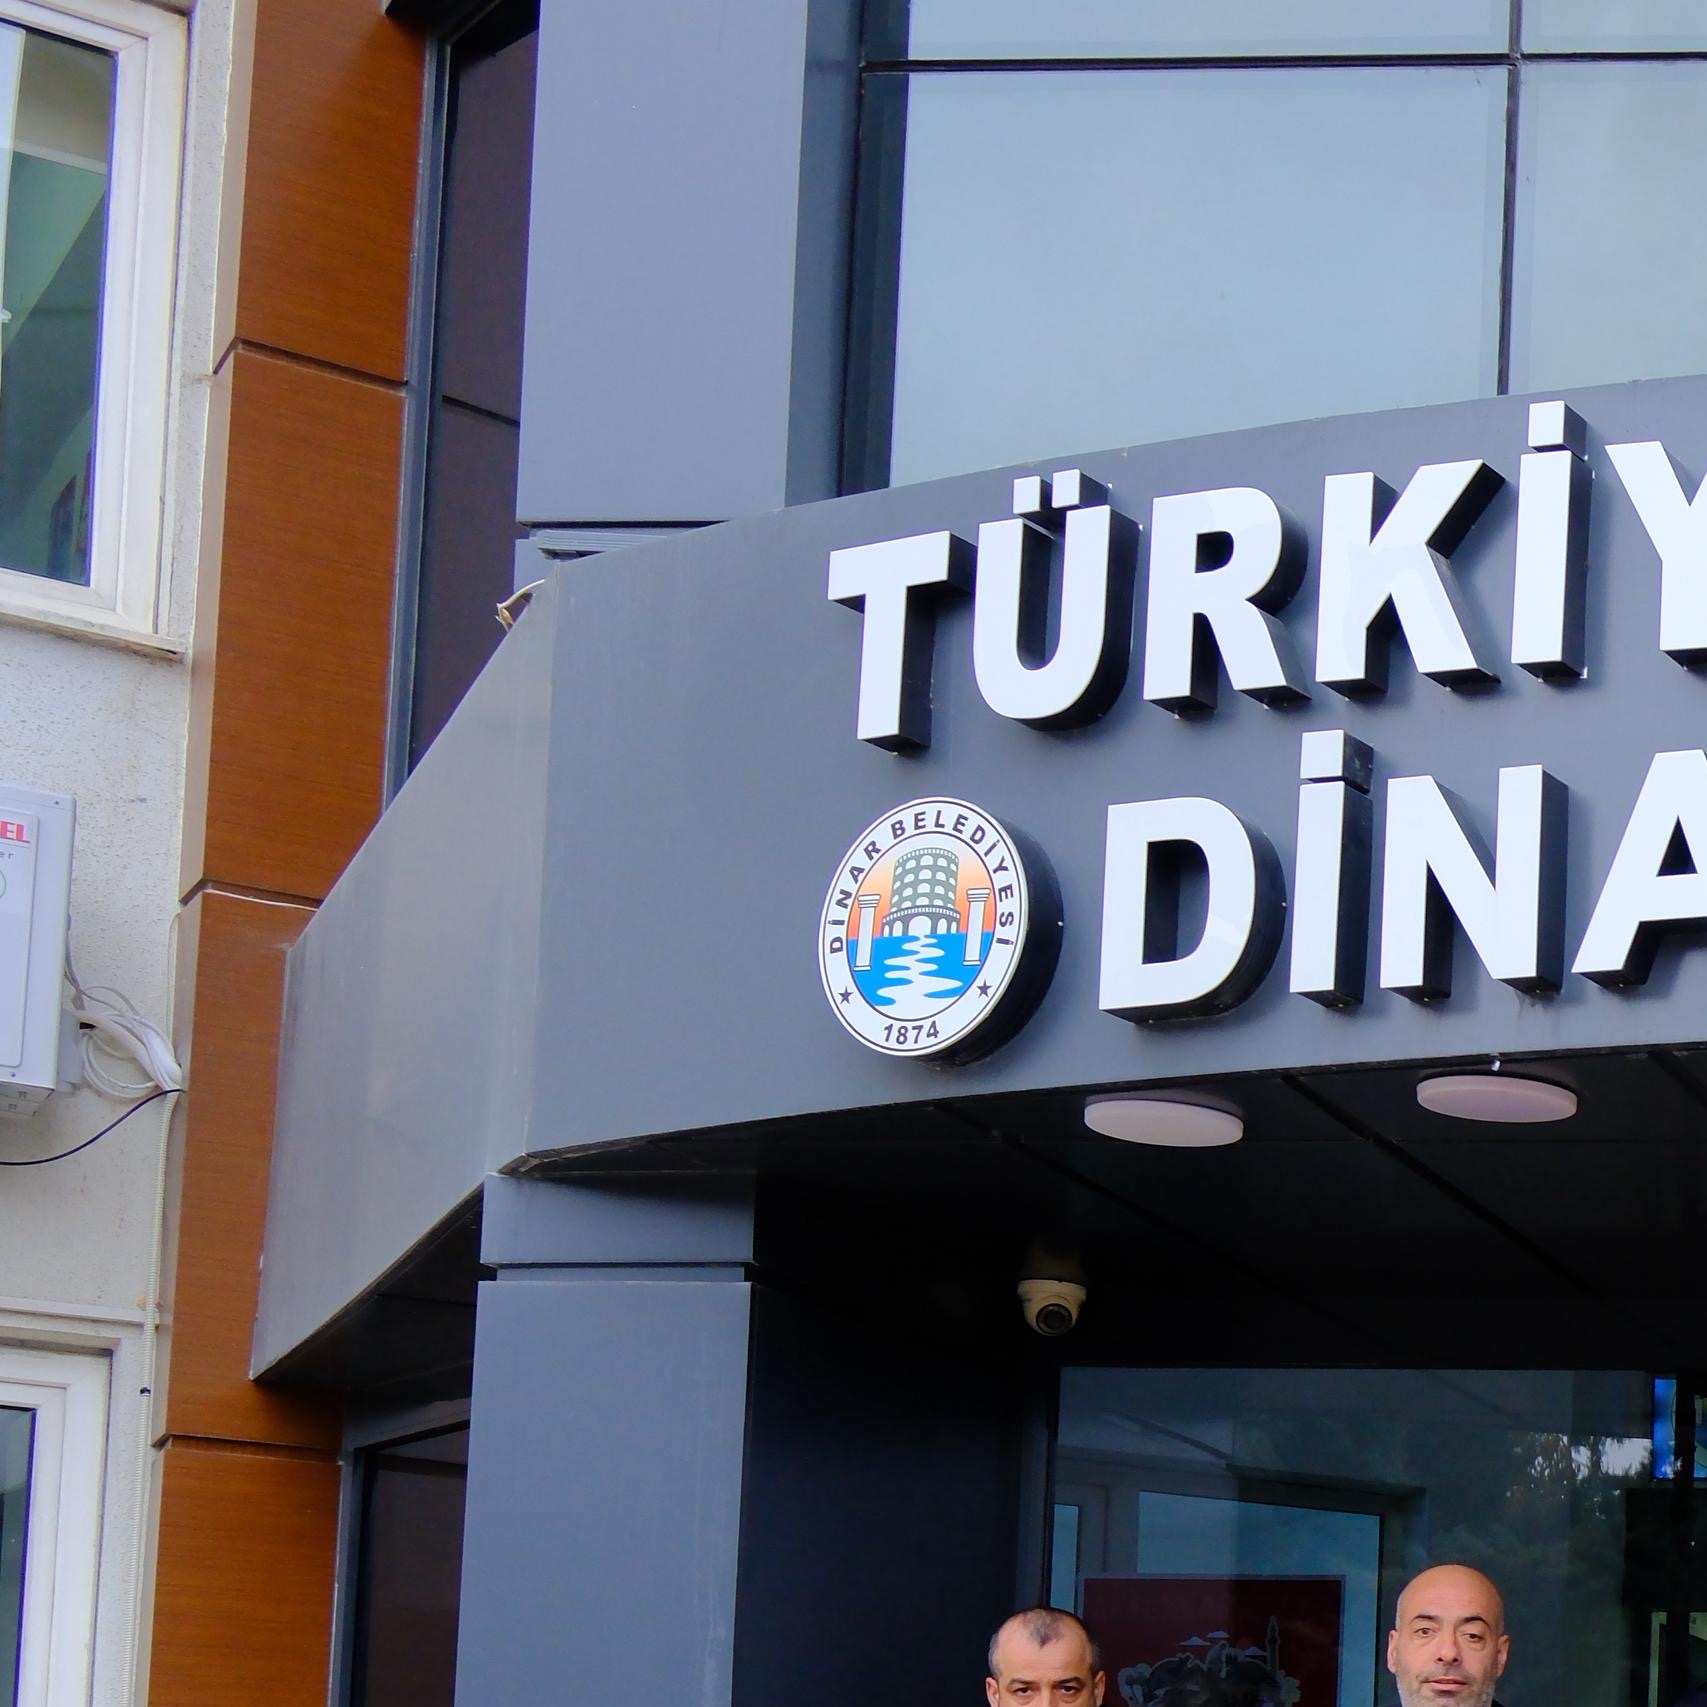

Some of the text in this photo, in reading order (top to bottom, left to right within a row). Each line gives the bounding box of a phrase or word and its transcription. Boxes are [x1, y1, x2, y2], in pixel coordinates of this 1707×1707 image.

[828, 810, 1015, 954] DİNAR BELEDİYESİ
[883, 1020, 940, 1045] 1874
